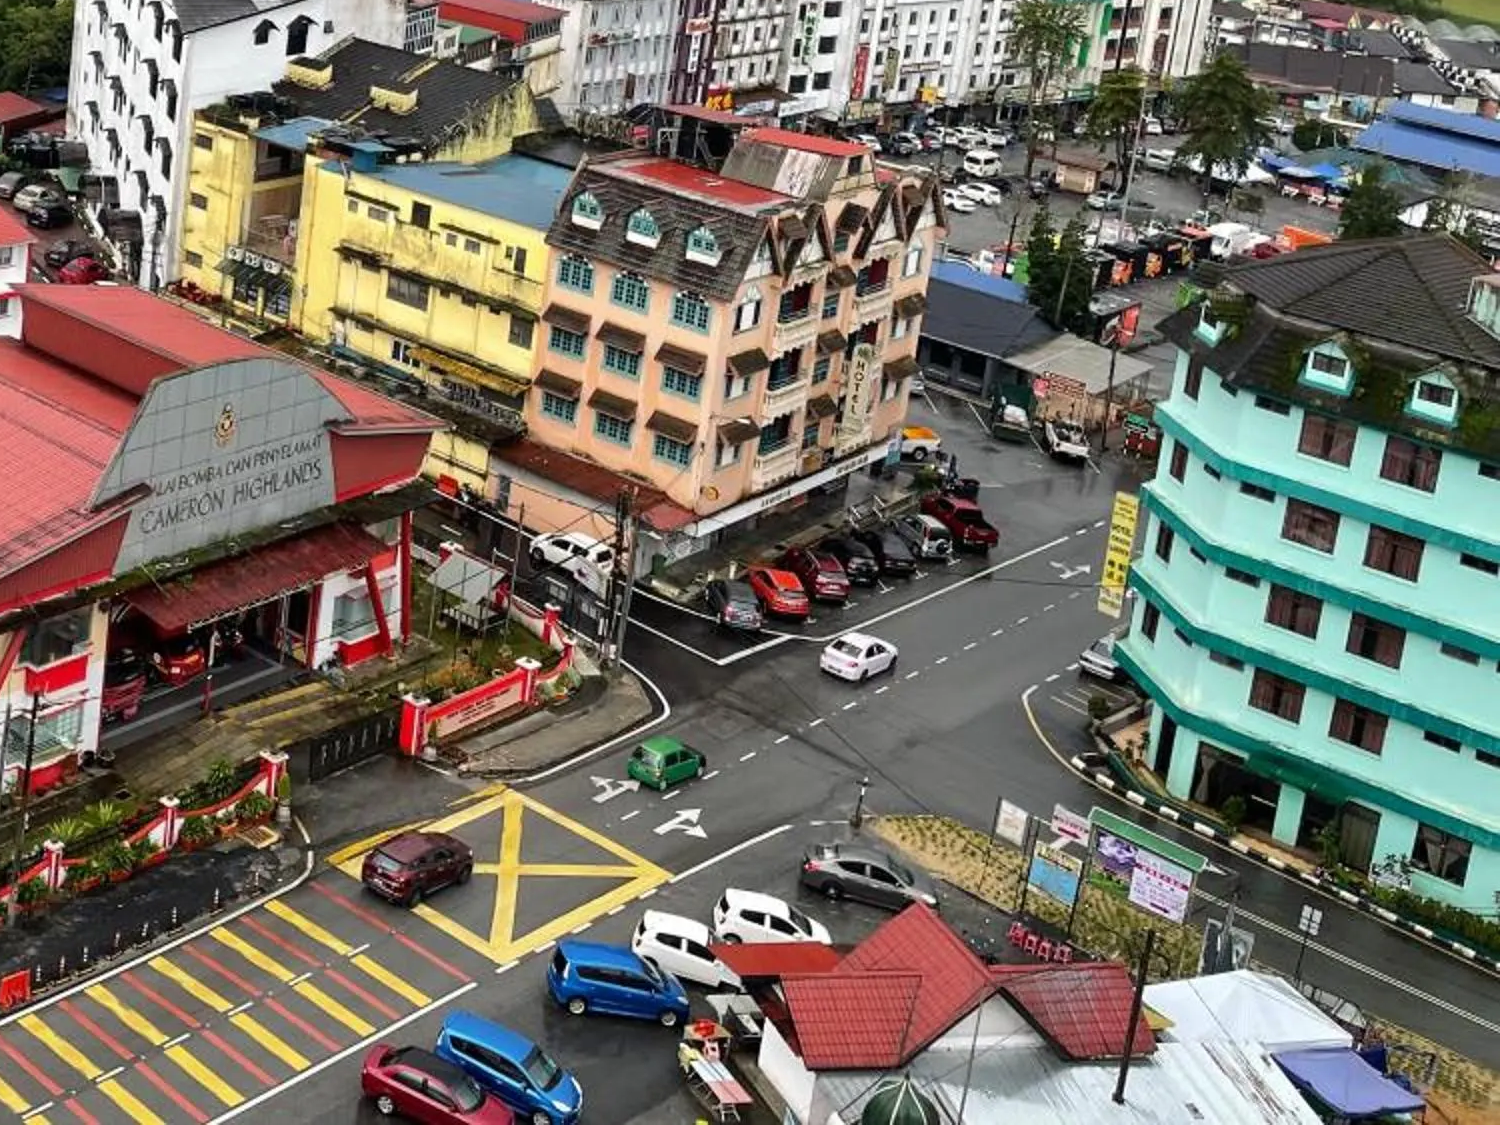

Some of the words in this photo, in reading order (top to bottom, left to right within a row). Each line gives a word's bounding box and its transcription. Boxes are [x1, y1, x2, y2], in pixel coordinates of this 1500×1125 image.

[851, 359, 865, 415] HOTEL
[178, 465, 222, 490] BOMBA
[225, 455, 251, 476] DAN
[253, 434, 322, 467] PENYELAMAT
[139, 489, 226, 534] CAMERON
[233, 458, 322, 505] HIGHLANDS
